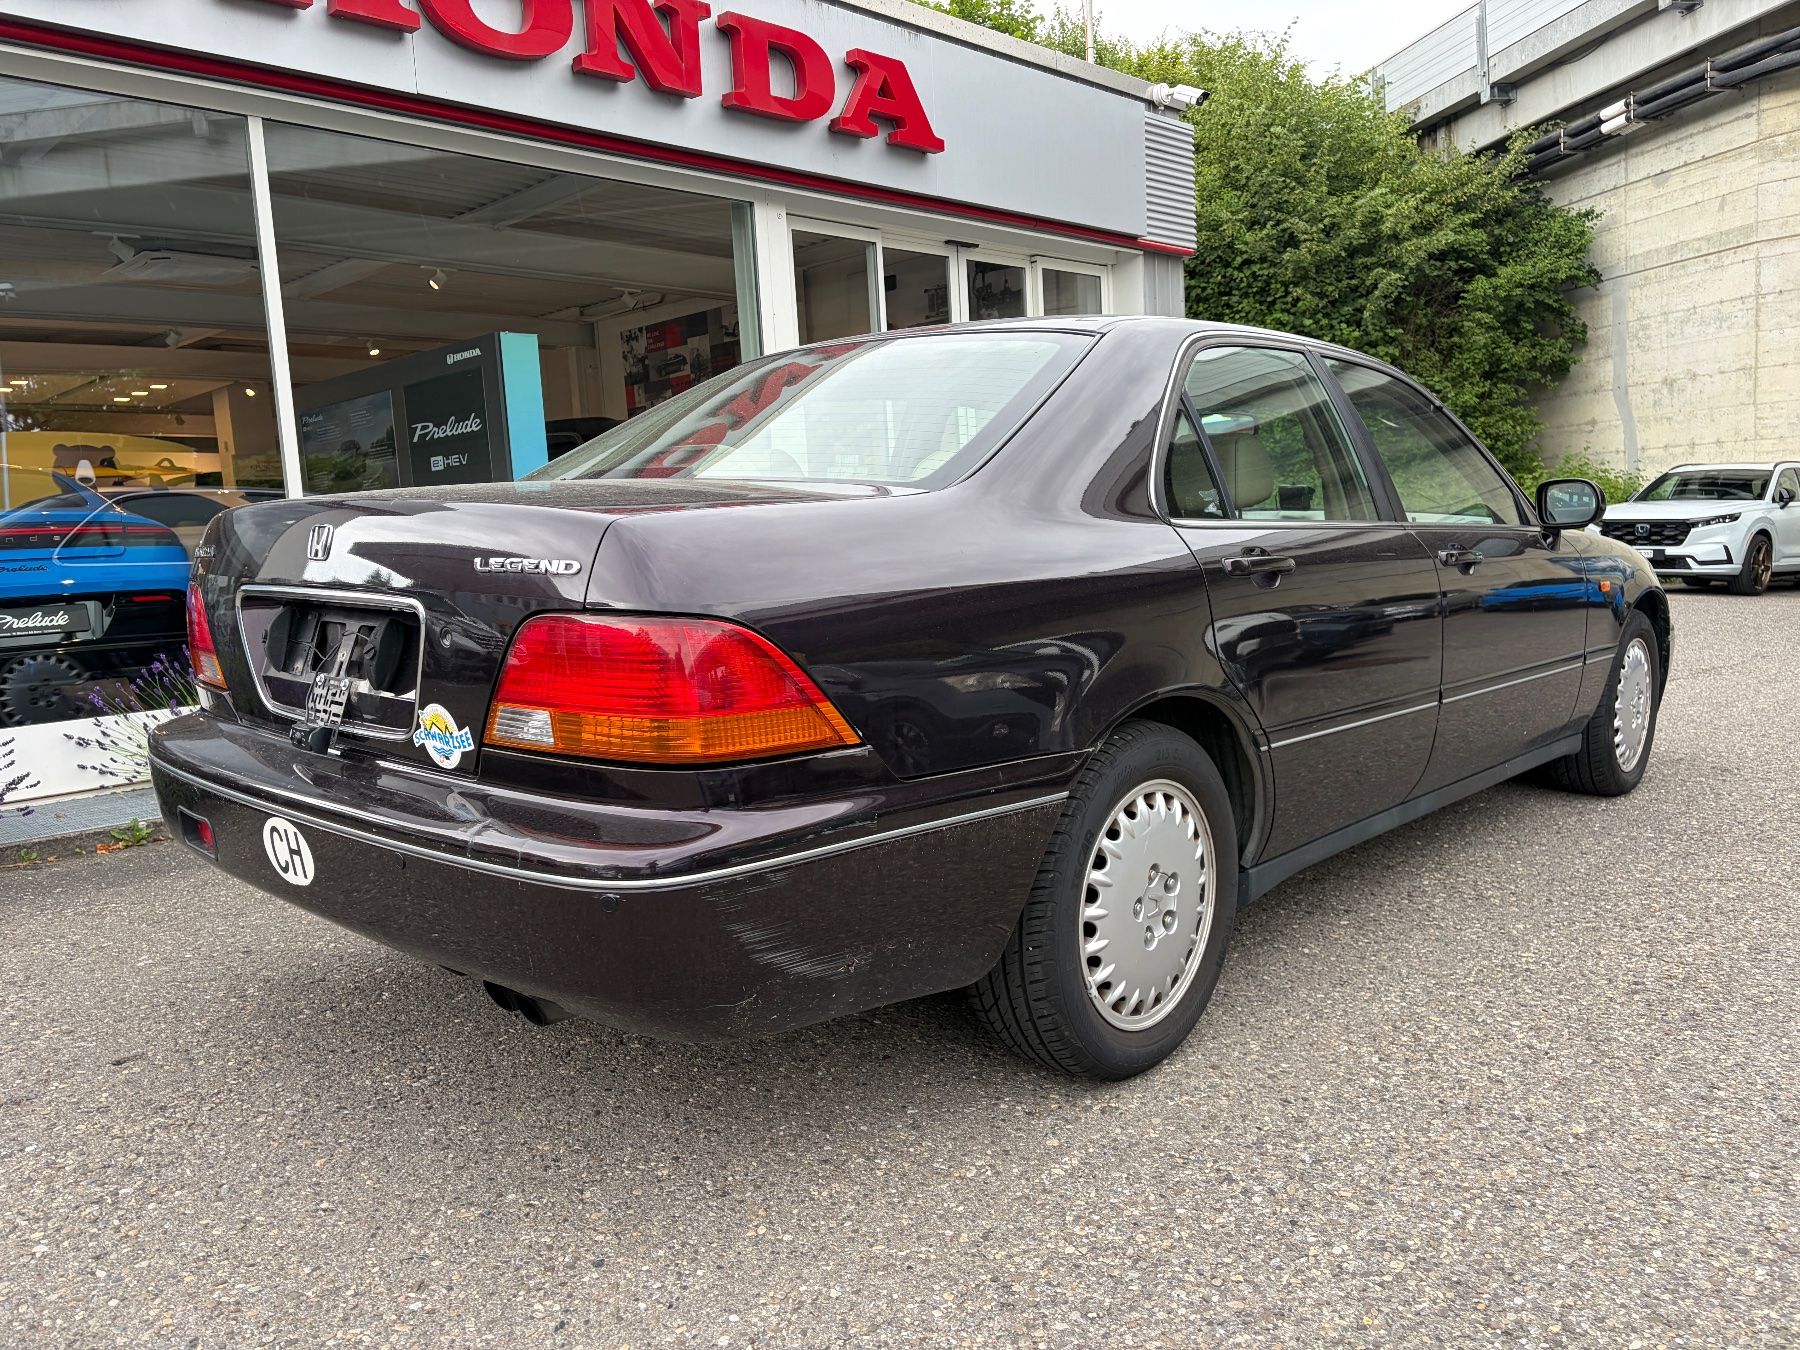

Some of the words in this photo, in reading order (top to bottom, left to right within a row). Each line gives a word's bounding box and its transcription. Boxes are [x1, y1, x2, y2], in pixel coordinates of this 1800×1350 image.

[258, 0, 944, 154] ONDA
[453, 348, 482, 361] HONDA
[411, 413, 482, 442] Prelude
[473, 557, 582, 575] LEGEND
[0, 611, 70, 629] Prelude
[415, 729, 472, 749] SCHWARZSEE
[269, 825, 308, 879] CH
